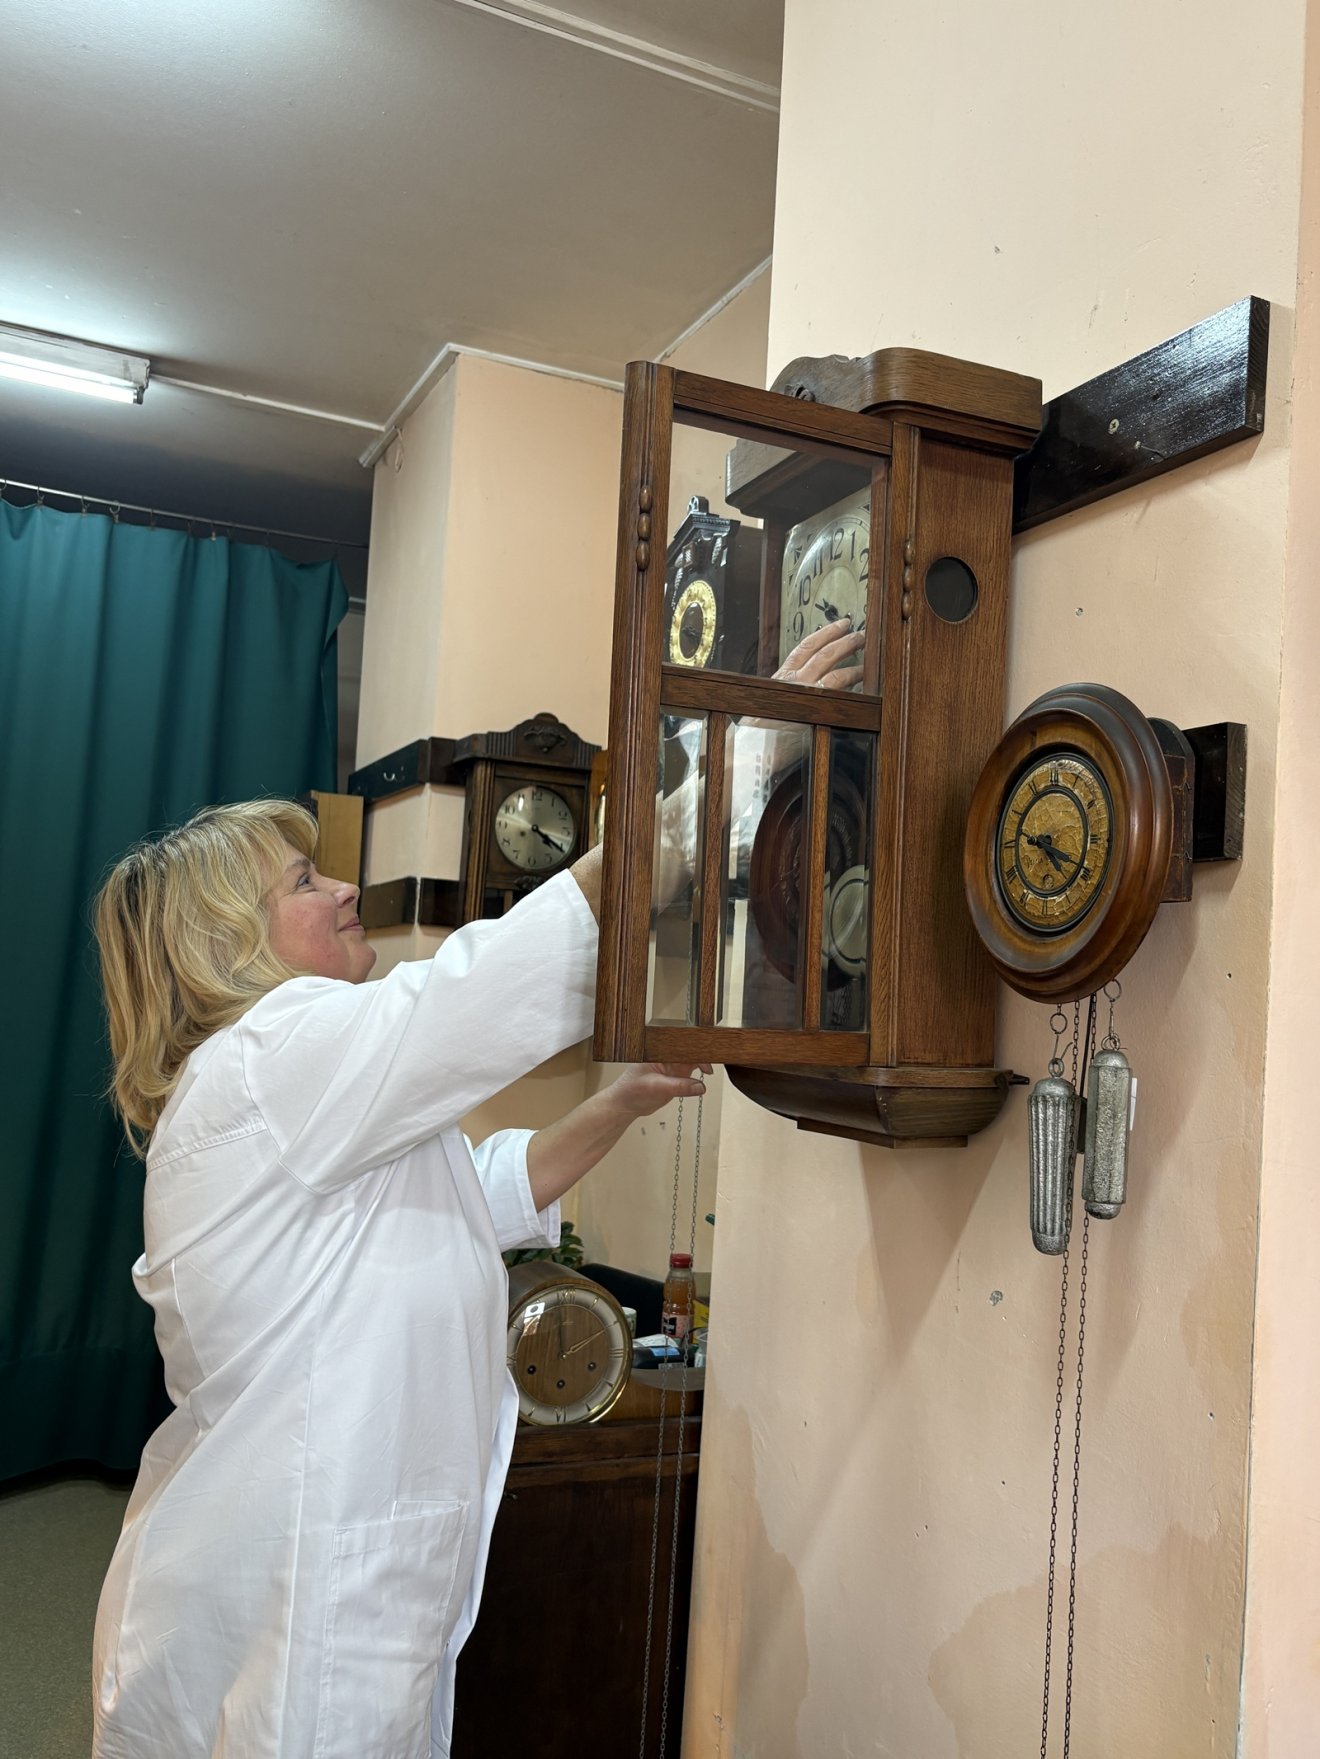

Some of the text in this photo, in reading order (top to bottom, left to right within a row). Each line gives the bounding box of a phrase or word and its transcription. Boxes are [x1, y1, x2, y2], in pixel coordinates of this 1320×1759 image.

[829, 527, 845, 561] 12
[851, 530, 856, 562] 1
[813, 546, 824, 580] 11
[798, 574, 812, 607] 10
[793, 612, 804, 642] 9
[504, 804, 516, 815] 10
[532, 790, 543, 801] 12
[513, 849, 520, 860] 7
[559, 1289, 576, 1304] XII
